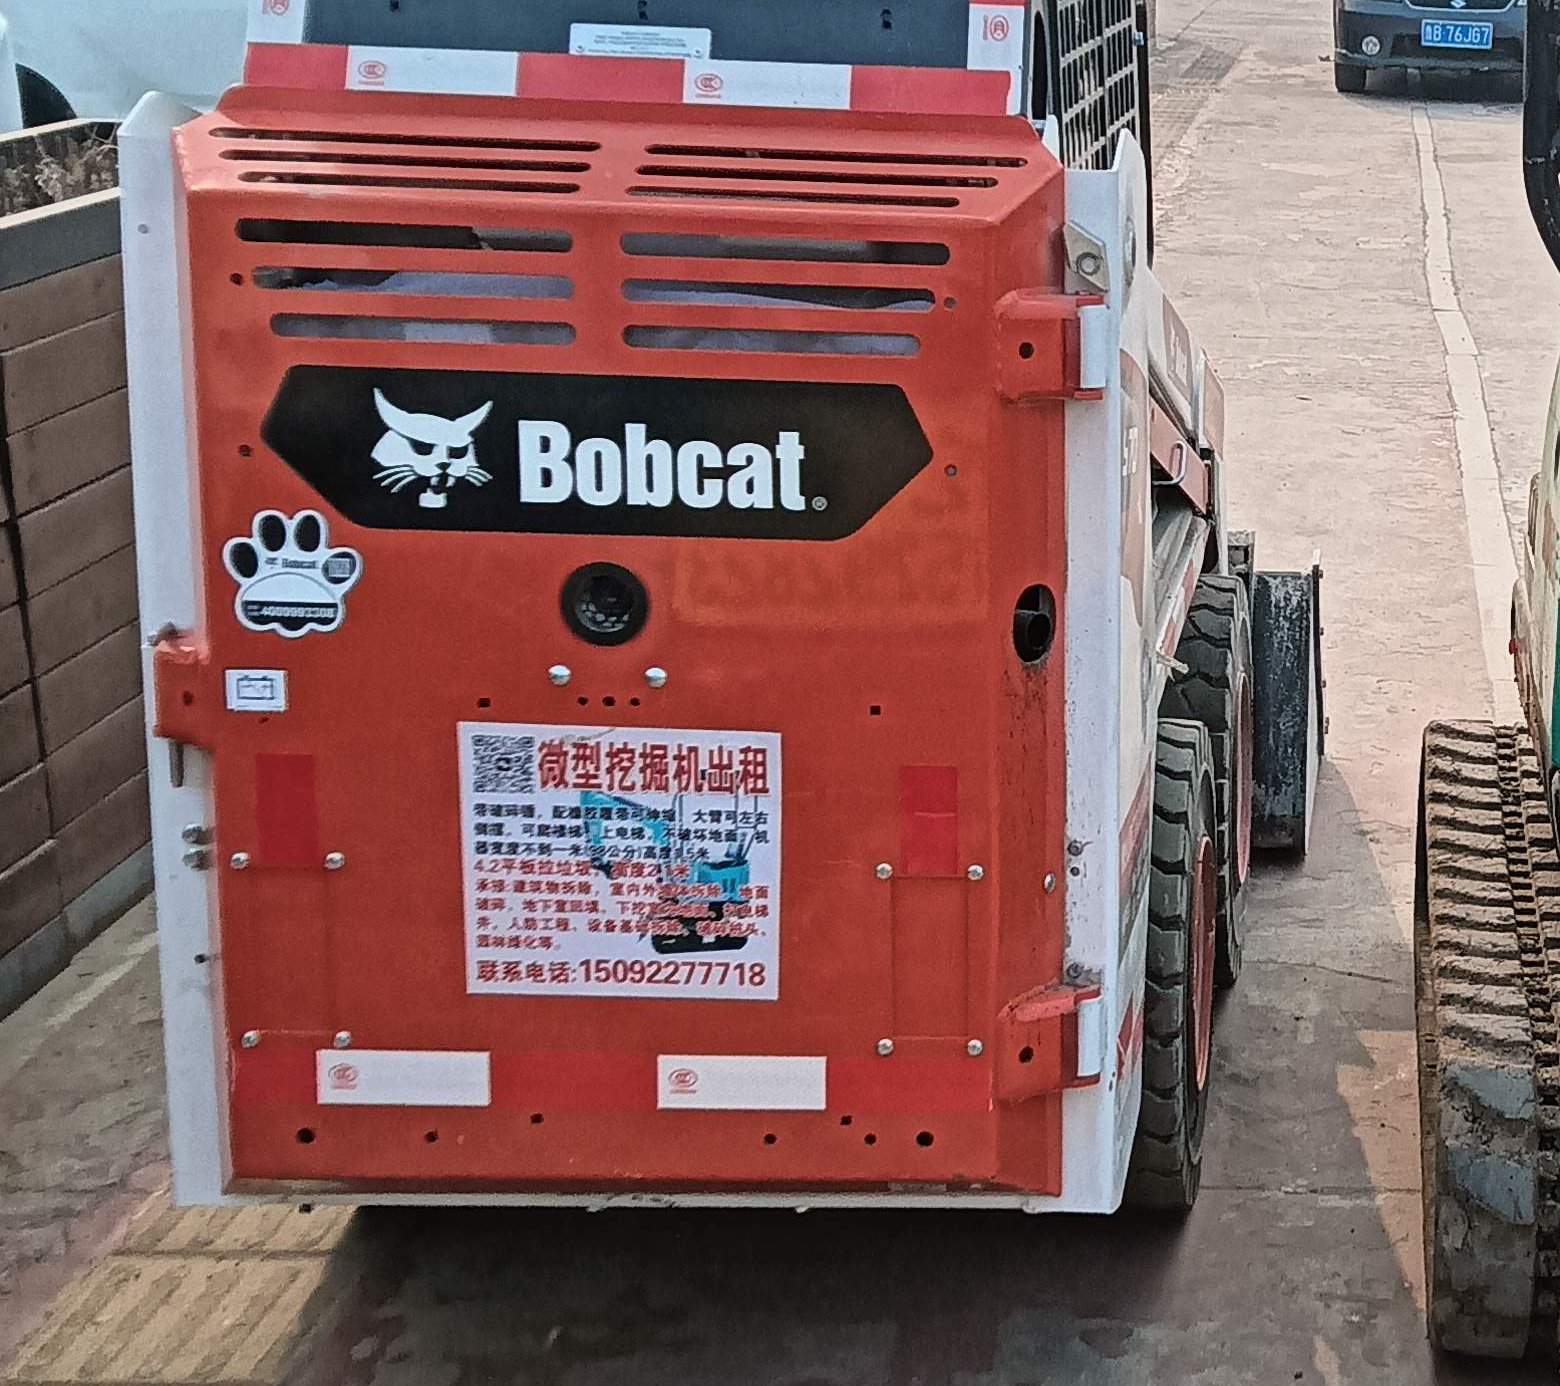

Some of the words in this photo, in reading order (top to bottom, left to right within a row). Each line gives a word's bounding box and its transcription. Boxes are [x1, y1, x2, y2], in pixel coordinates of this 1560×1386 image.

[517, 419, 806, 511] Bobcat
[538, 739, 770, 795] 微型挖掘机出租
